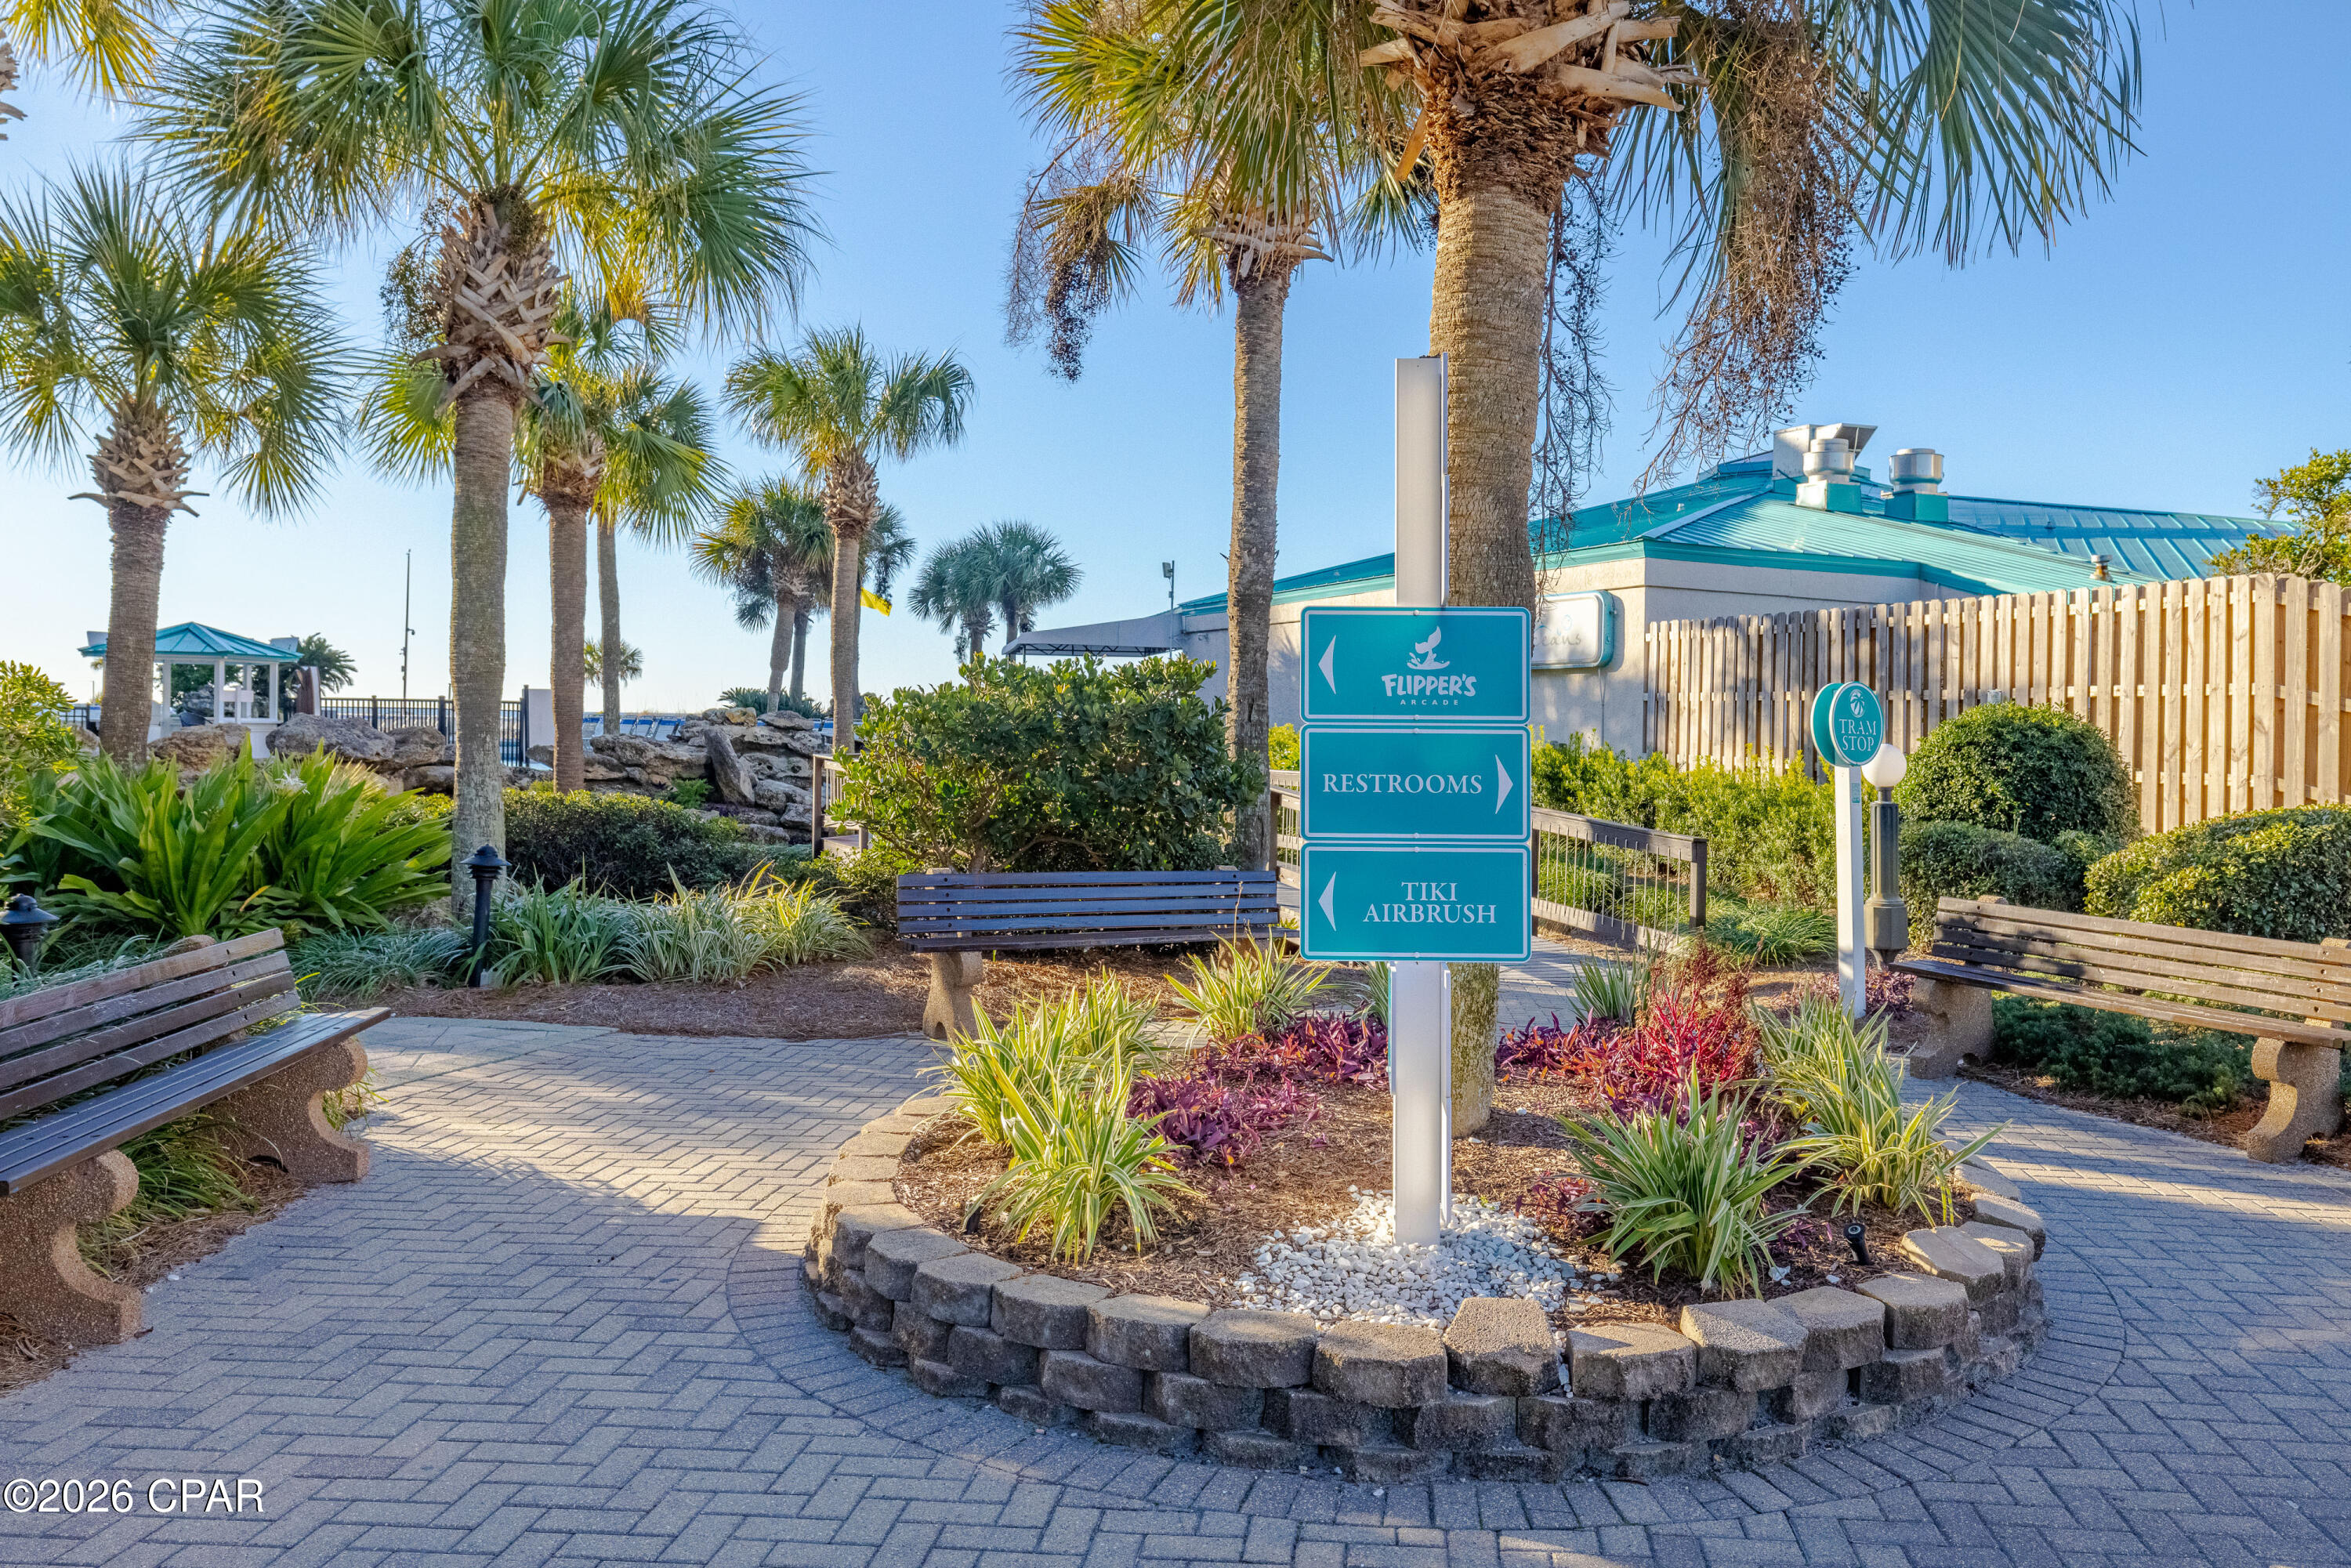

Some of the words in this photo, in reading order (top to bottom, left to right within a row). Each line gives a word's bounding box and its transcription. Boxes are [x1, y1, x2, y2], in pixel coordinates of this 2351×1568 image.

[1382, 674, 1476, 697] FLIPPER'S
[1838, 719, 1876, 735] TRAM
[1842, 736, 1874, 751] STOP
[1323, 773, 1482, 794] RESTROOMS
[1401, 882, 1457, 902] TIKI
[1363, 904, 1497, 924] AIRBRUSH
